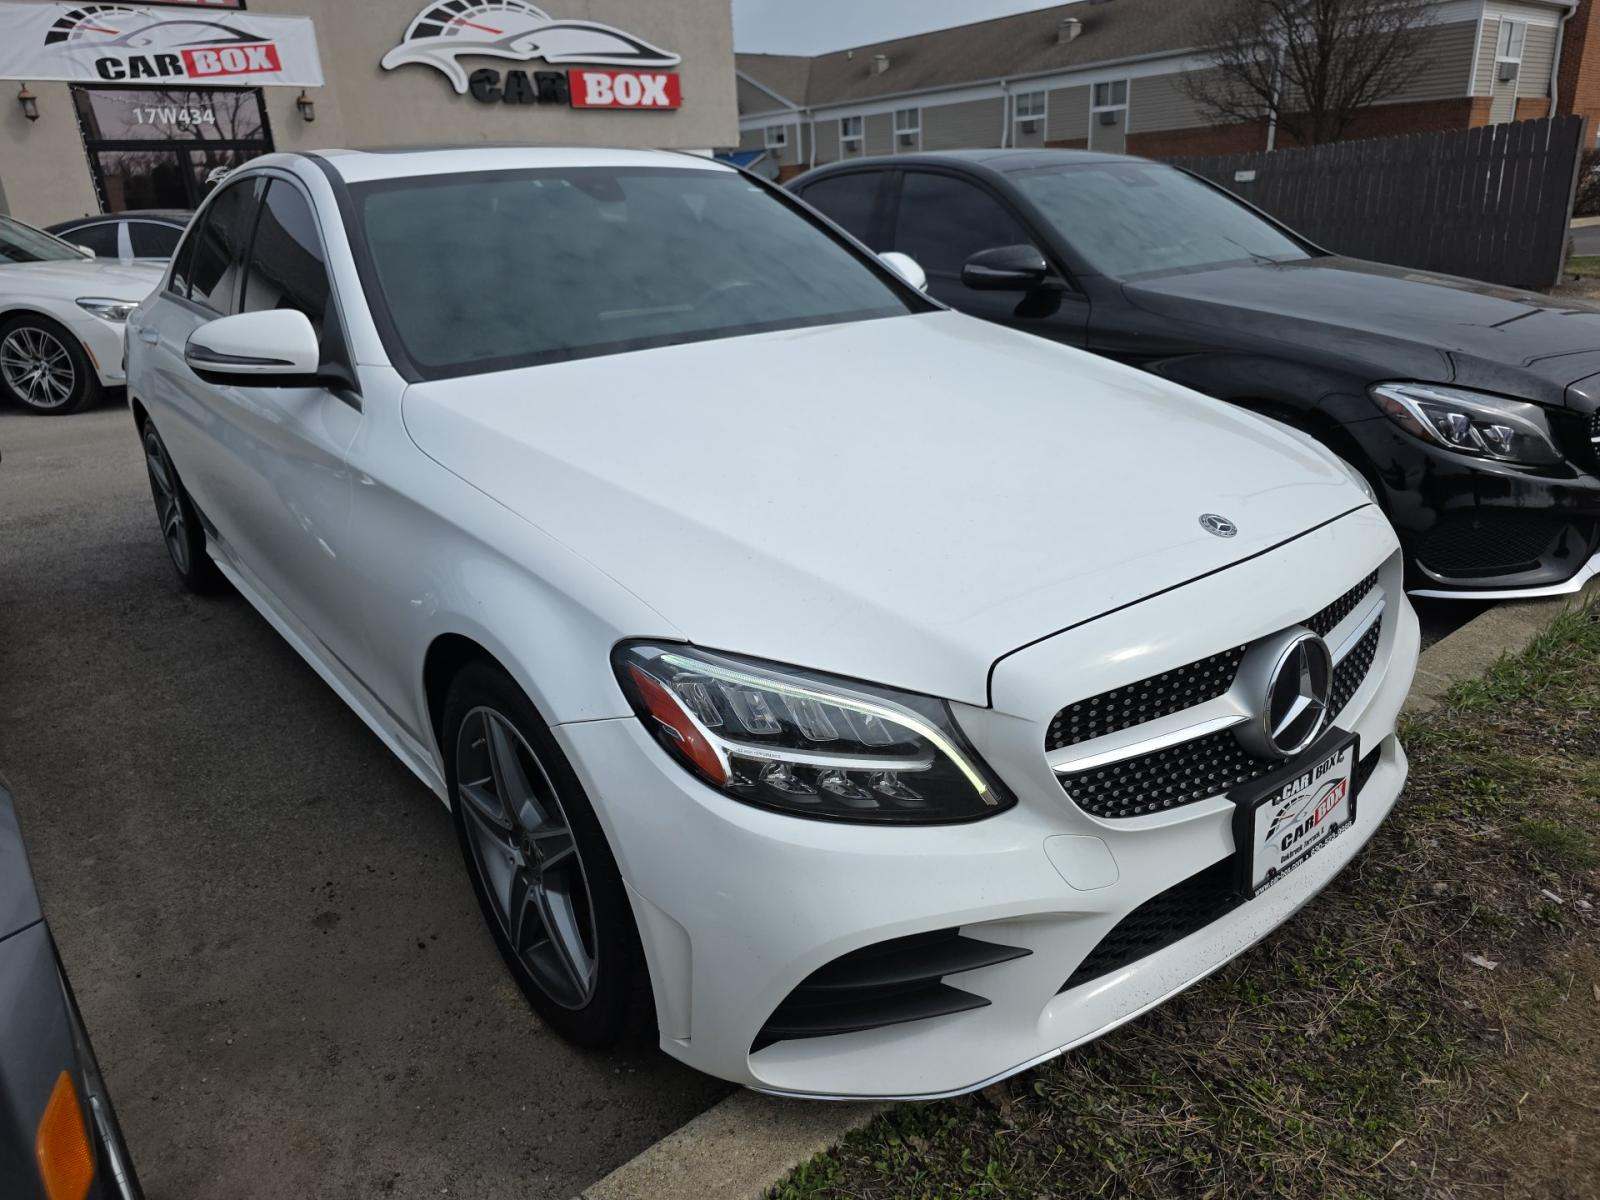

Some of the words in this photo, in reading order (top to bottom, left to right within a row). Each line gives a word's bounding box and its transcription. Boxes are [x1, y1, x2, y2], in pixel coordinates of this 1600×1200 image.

[95, 53, 184, 80] CAR
[191, 44, 275, 73] BOX
[468, 68, 568, 105] CAR
[583, 73, 670, 106] BOX
[132, 107, 215, 125] 17W434
[1282, 773, 1310, 800] CAR
[1316, 756, 1337, 779] BOX
[1281, 814, 1314, 852] CAR
[1319, 783, 1344, 816] BOX
